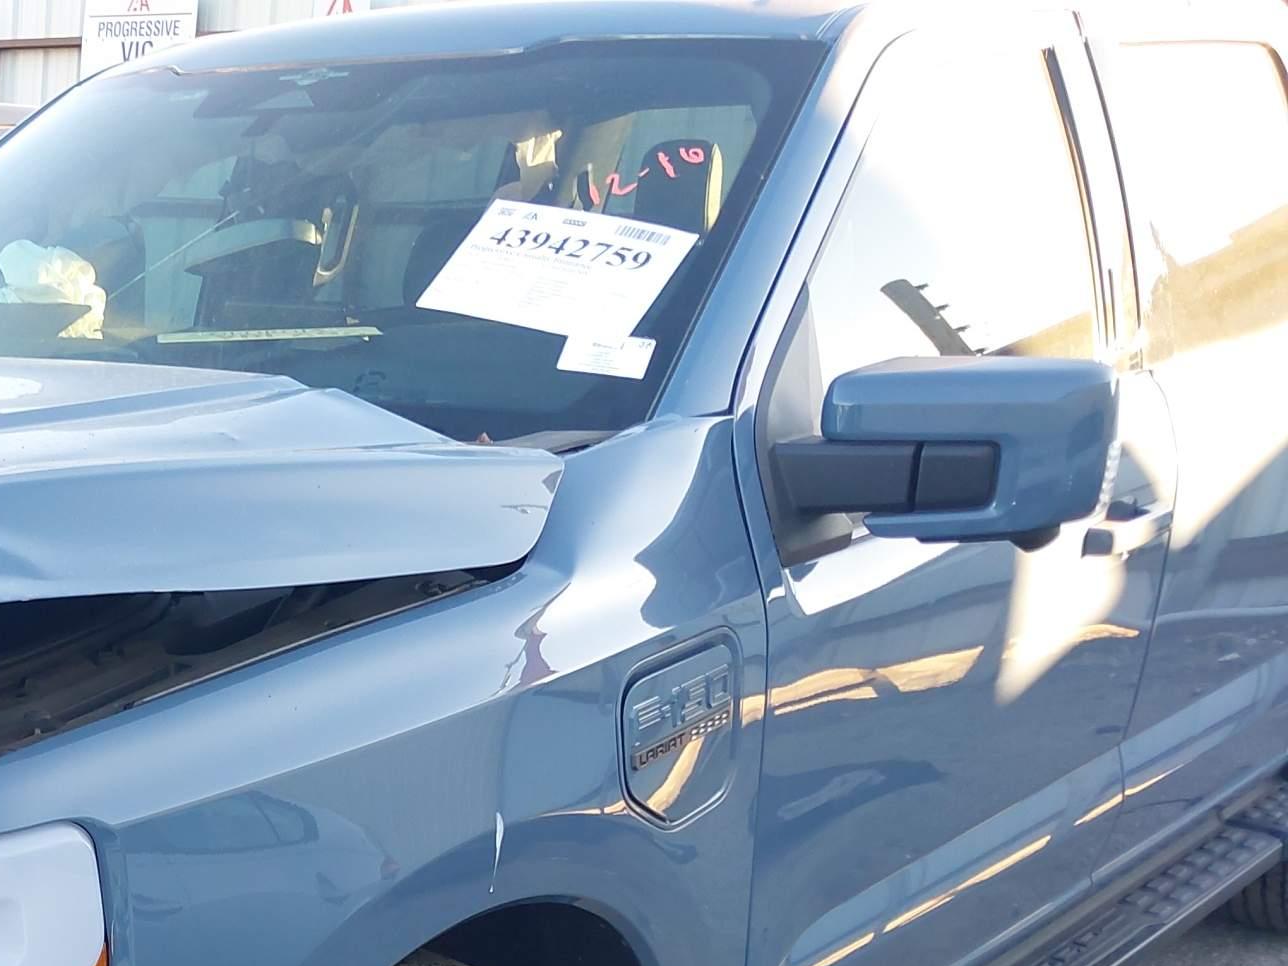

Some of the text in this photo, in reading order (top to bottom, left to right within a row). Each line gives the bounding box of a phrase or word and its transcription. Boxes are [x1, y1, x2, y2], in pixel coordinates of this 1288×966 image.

[97, 19, 181, 39] PROGRESSIVE
[489, 227, 652, 270] 43942759
[638, 733, 686, 767] LARIAT
